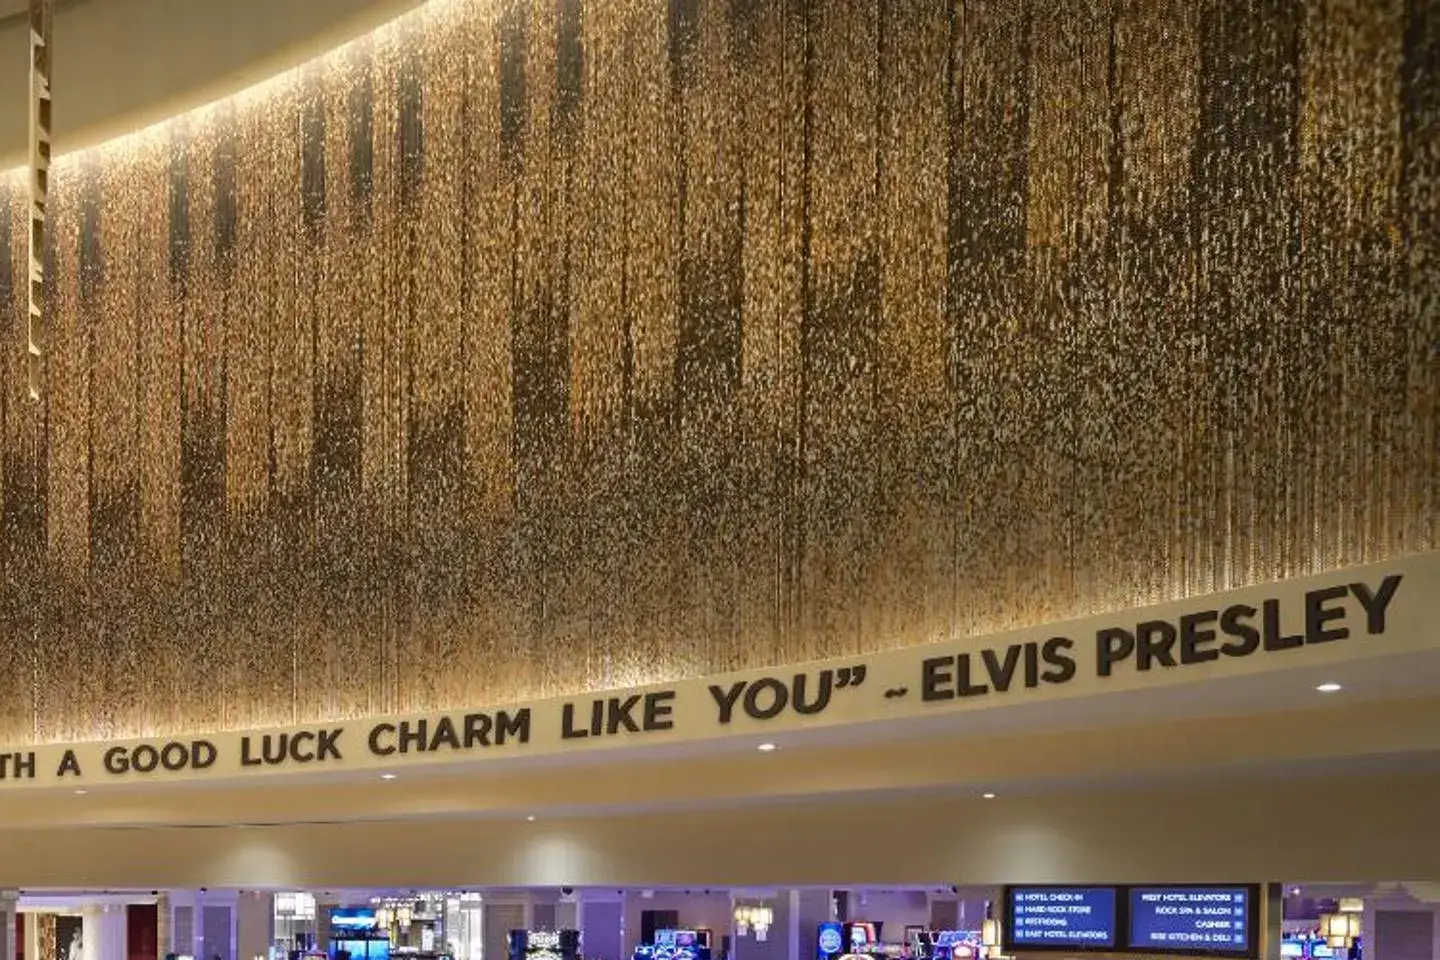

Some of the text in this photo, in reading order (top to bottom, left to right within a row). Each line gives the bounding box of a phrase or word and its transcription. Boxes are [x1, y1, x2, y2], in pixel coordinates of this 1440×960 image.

[56, 749, 81, 777] A
[103, 740, 218, 774] GOOD
[240, 728, 344, 766] LUCK
[367, 707, 531, 755] CHARM
[561, 690, 675, 739] LIKE
[921, 636, 1076, 702] ELVIS
[1096, 574, 1403, 678] PRESLEY
[1025, 893, 1048, 901] HOTEL
[1163, 893, 1188, 901] HOTEL
[1189, 893, 1231, 901] ELEVATORS
[1025, 906, 1046, 914] HARD
[1047, 906, 1067, 914] ROCK
[1155, 906, 1232, 915] ROCK SPA & SALON
[1025, 918, 1068, 927] RESTROOMS
[1195, 920, 1231, 928] CASHIER
[1068, 931, 1108, 940] ELEVATORS
[1168, 933, 1203, 942] KITCHEN
[1212, 934, 1231, 942] DELI
